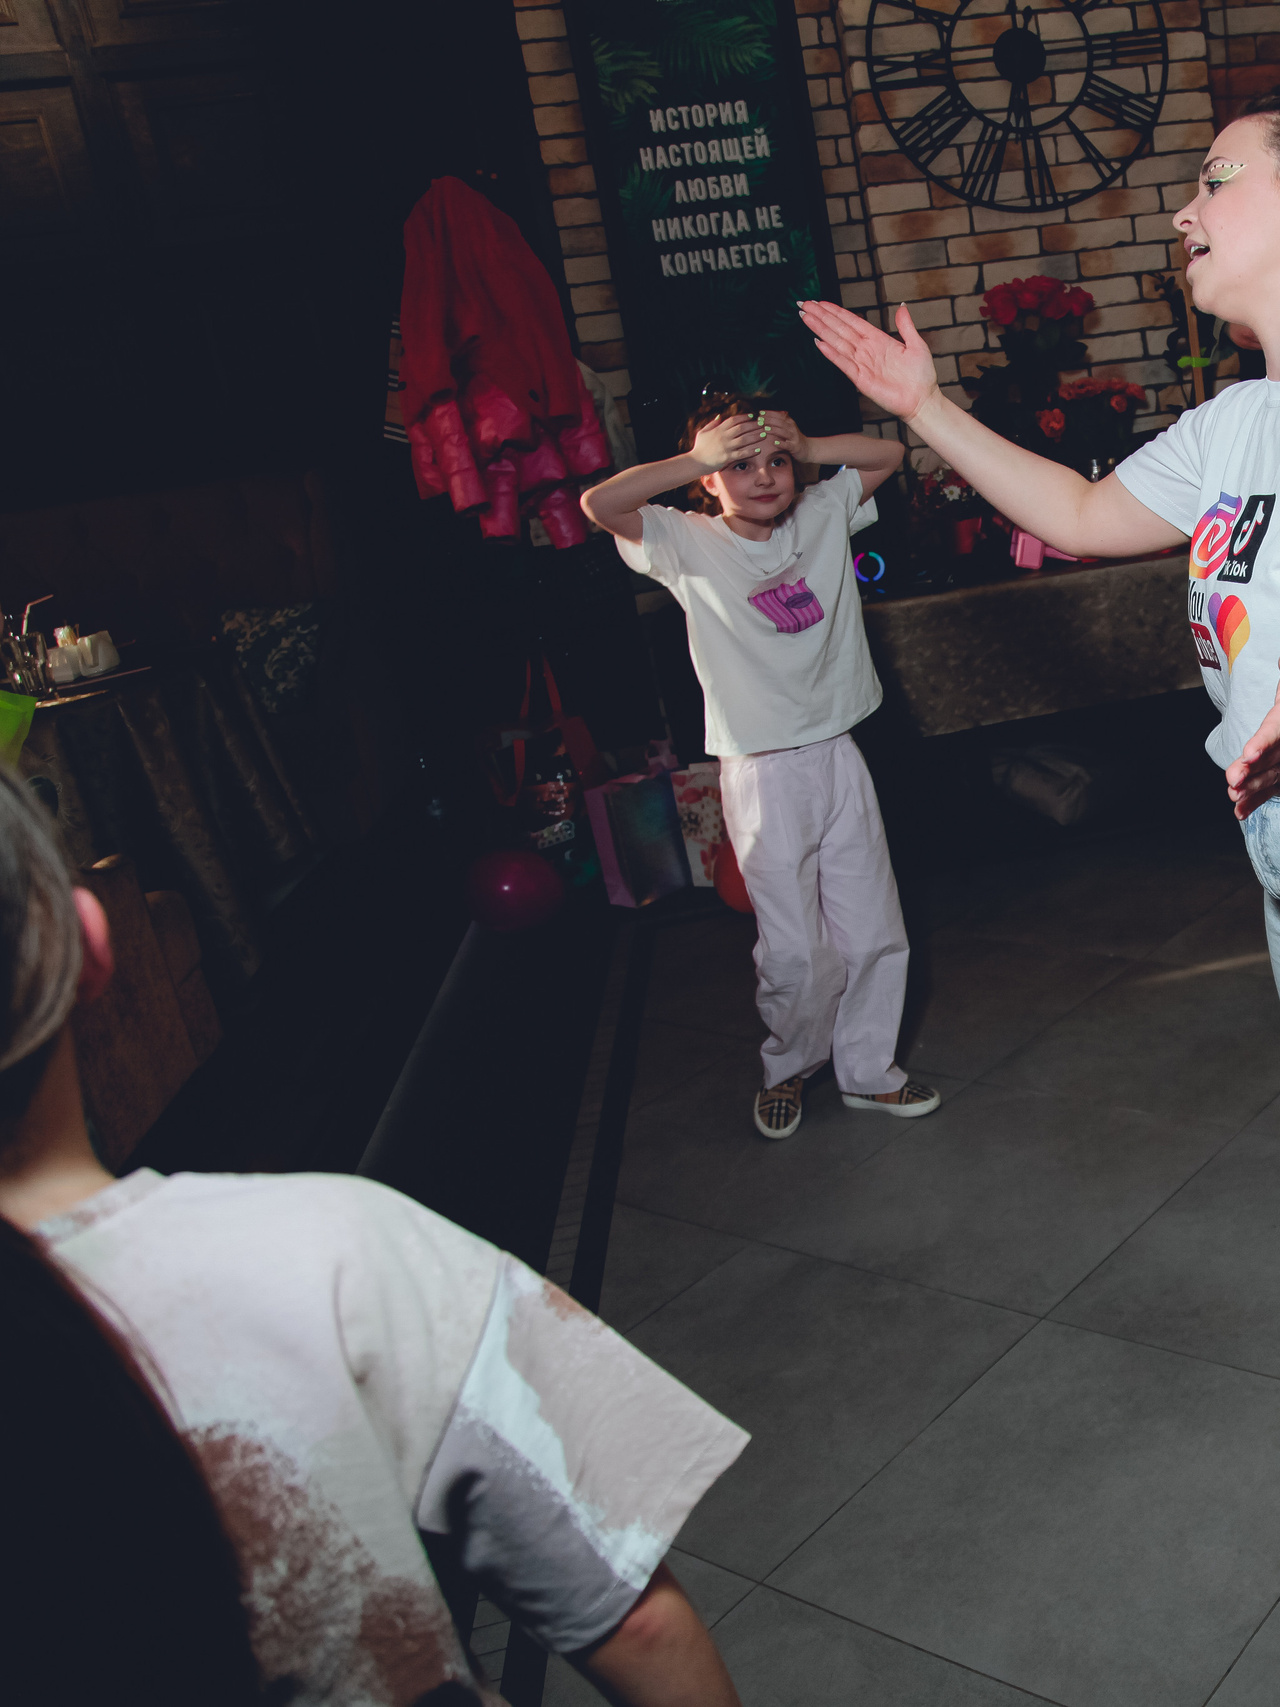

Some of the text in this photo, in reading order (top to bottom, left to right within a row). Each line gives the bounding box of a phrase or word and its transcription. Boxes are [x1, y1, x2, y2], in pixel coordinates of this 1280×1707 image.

[649, 99, 749, 133] ИСТОРИЯ
[639, 127, 771, 172] НАСТОЯЩЕЙ
[674, 172, 750, 204] ЛЮБВИ
[651, 204, 784, 243] НИКОГДА НЕ
[660, 240, 788, 277] КОНЧАЕТСЯ.
[1188, 579, 1205, 623] You
